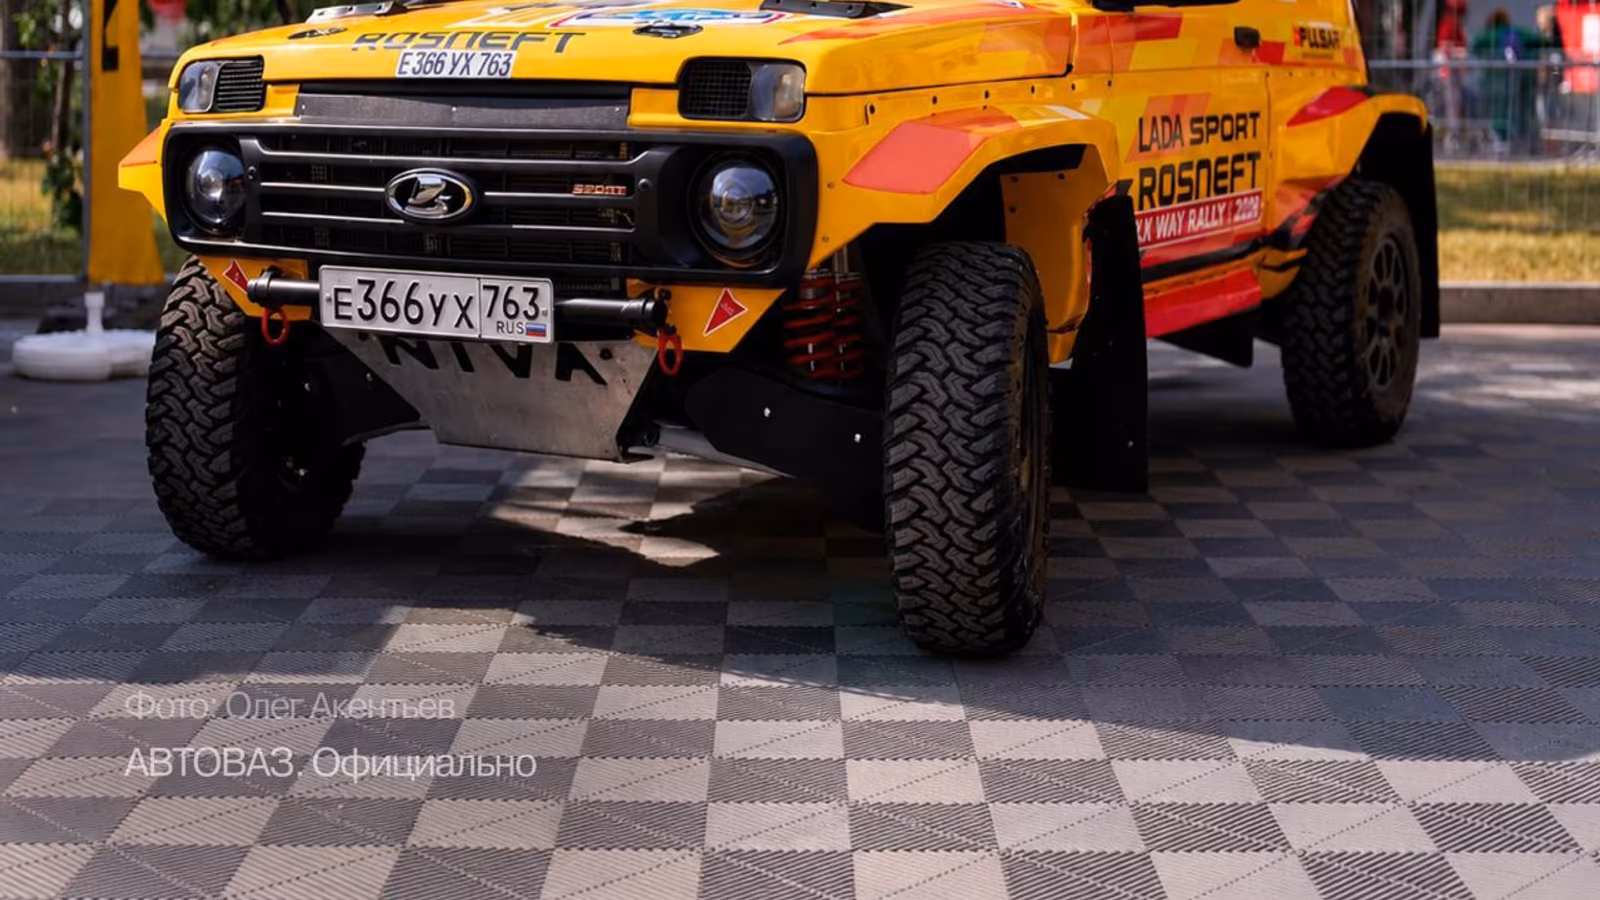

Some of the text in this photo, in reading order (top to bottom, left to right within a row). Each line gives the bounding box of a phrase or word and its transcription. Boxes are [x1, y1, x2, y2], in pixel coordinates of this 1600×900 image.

[352, 31, 586, 53] ROSNEFT
[476, 52, 513, 77] 763
[1138, 111, 1261, 152] LADA SPORT
[1138, 151, 1262, 211] ROSNEFT
[1155, 209, 1185, 240] WAY
[1187, 202, 1227, 233] RALLY
[482, 285, 541, 321] 763
[496, 320, 525, 335] RUS
